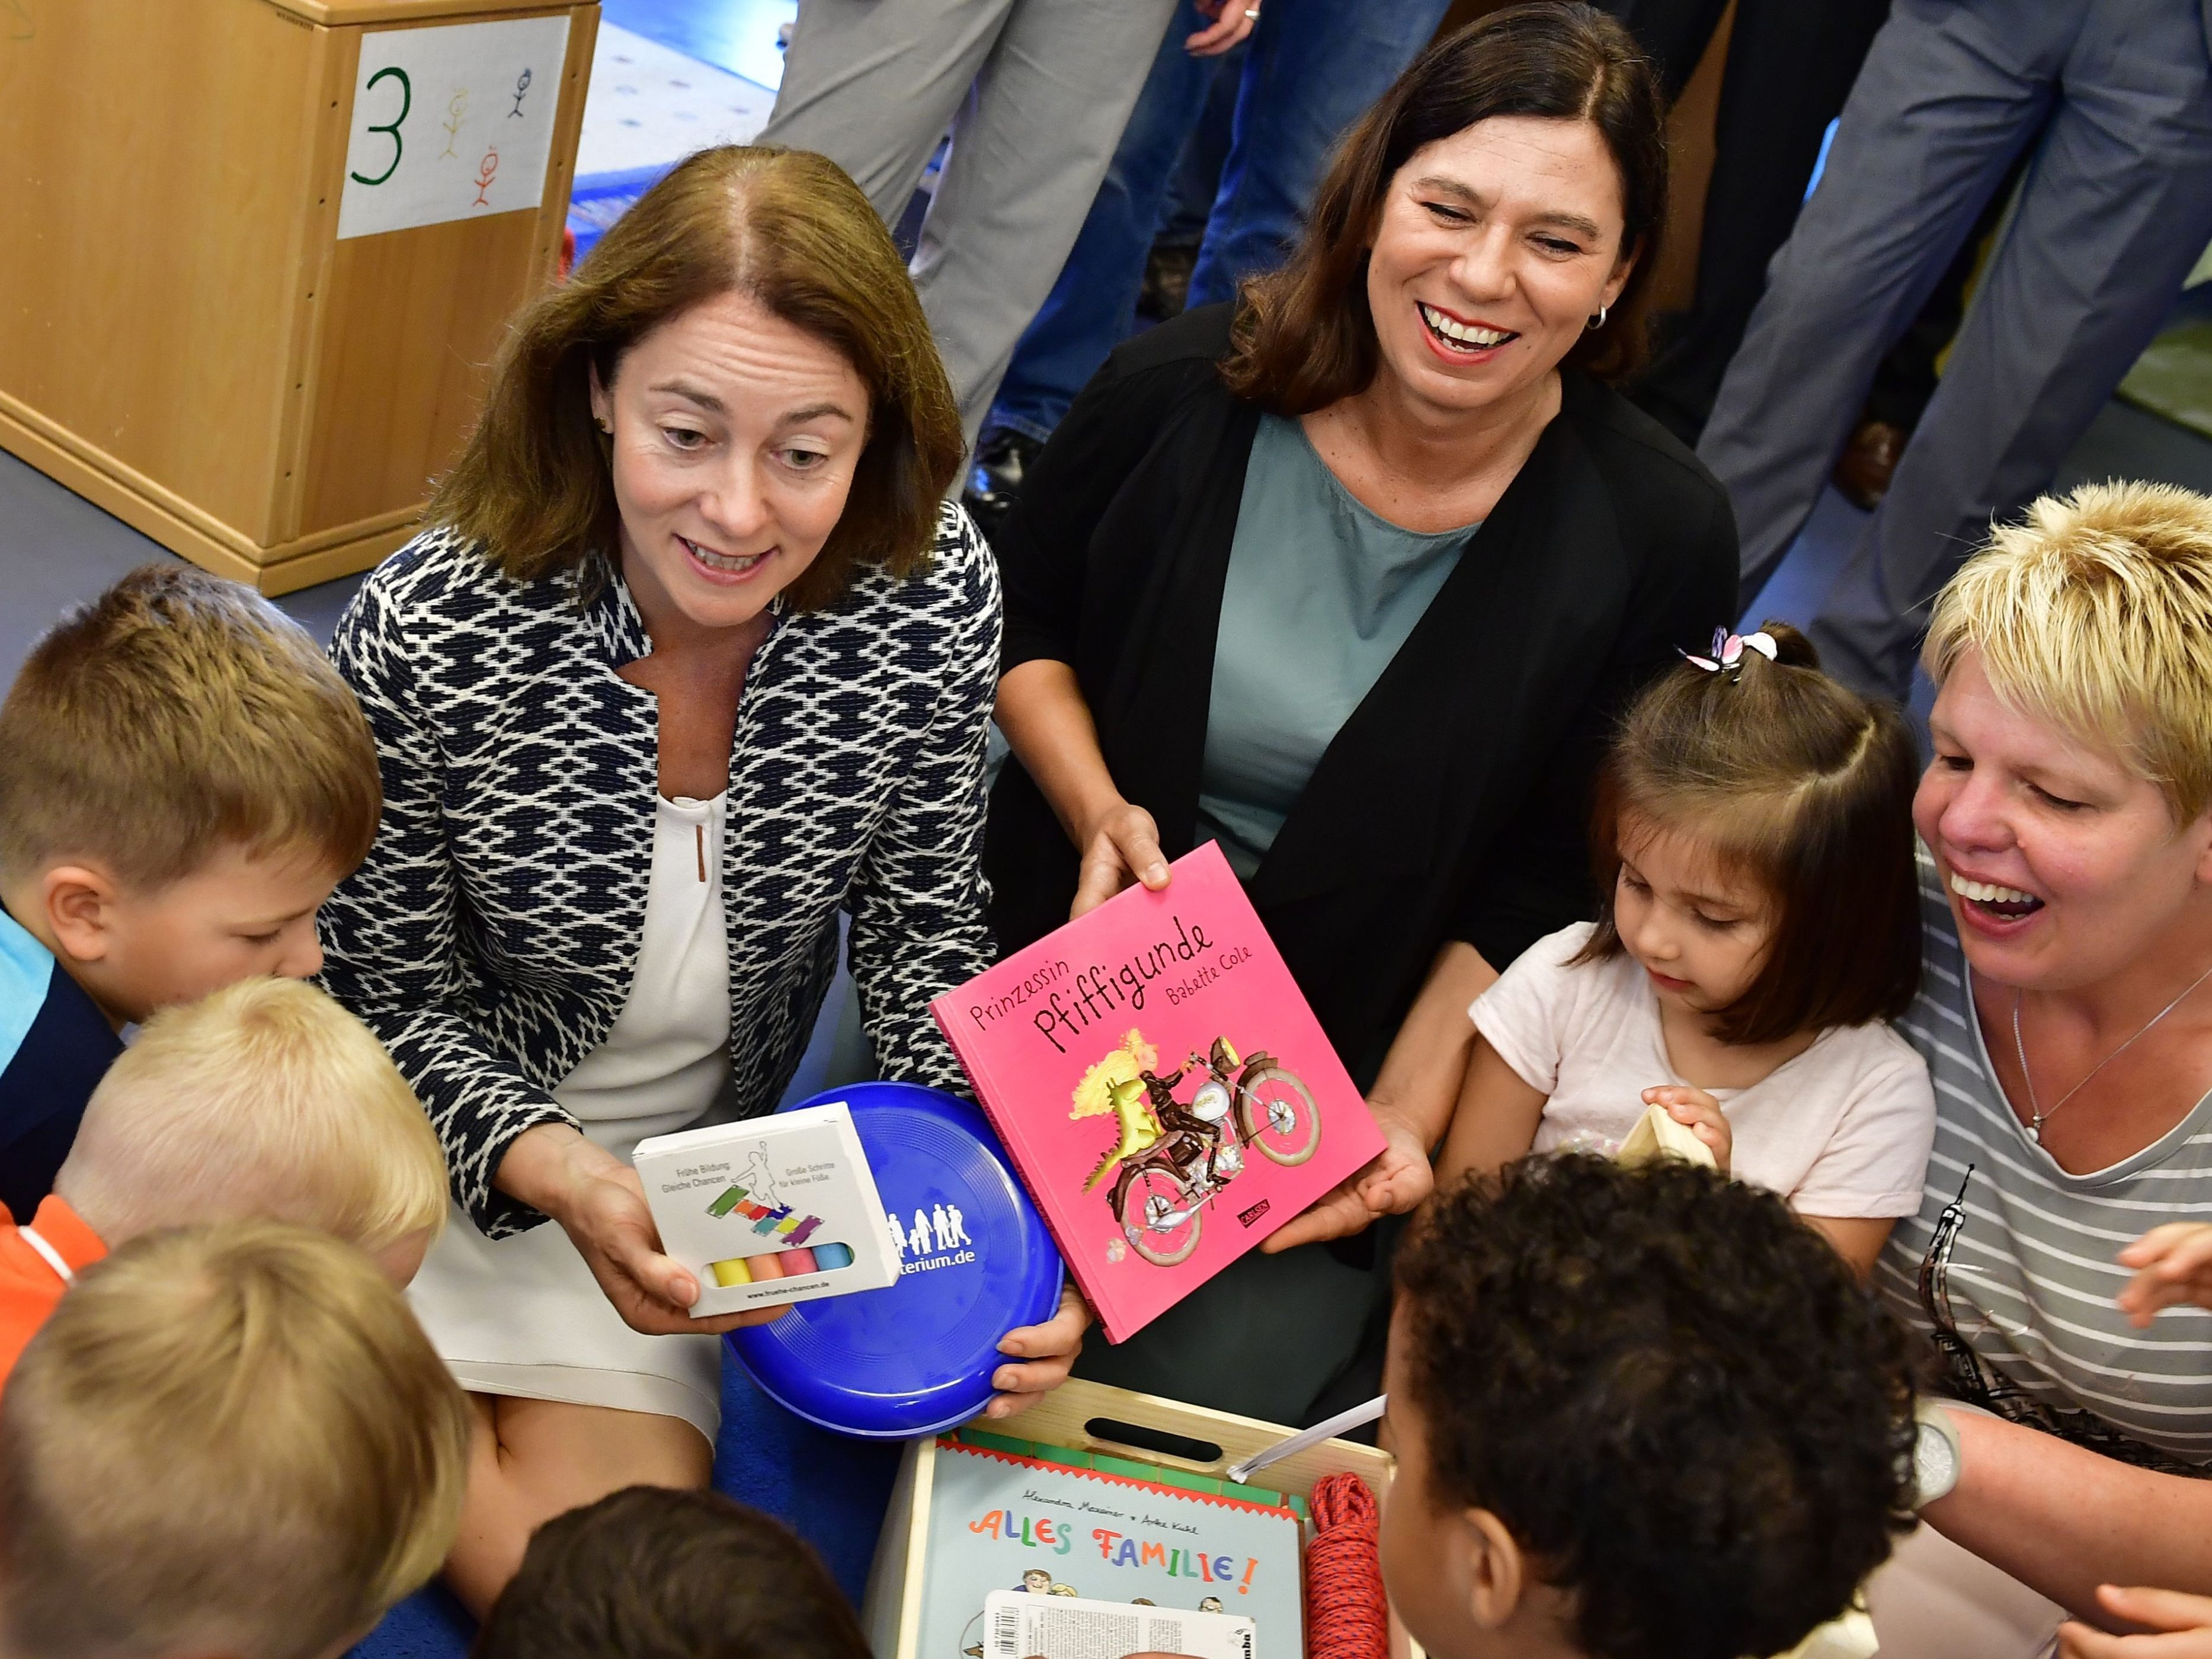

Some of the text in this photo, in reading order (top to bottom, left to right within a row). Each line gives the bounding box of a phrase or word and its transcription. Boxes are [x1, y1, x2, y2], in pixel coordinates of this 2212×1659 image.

[351, 67, 411, 185] 3
[969, 960, 1070, 1031] Prinzessin
[1165, 947, 1253, 1005] Babette Cole
[692, 1176, 726, 1187] Chancen
[968, 1509, 1072, 1555] ALLES
